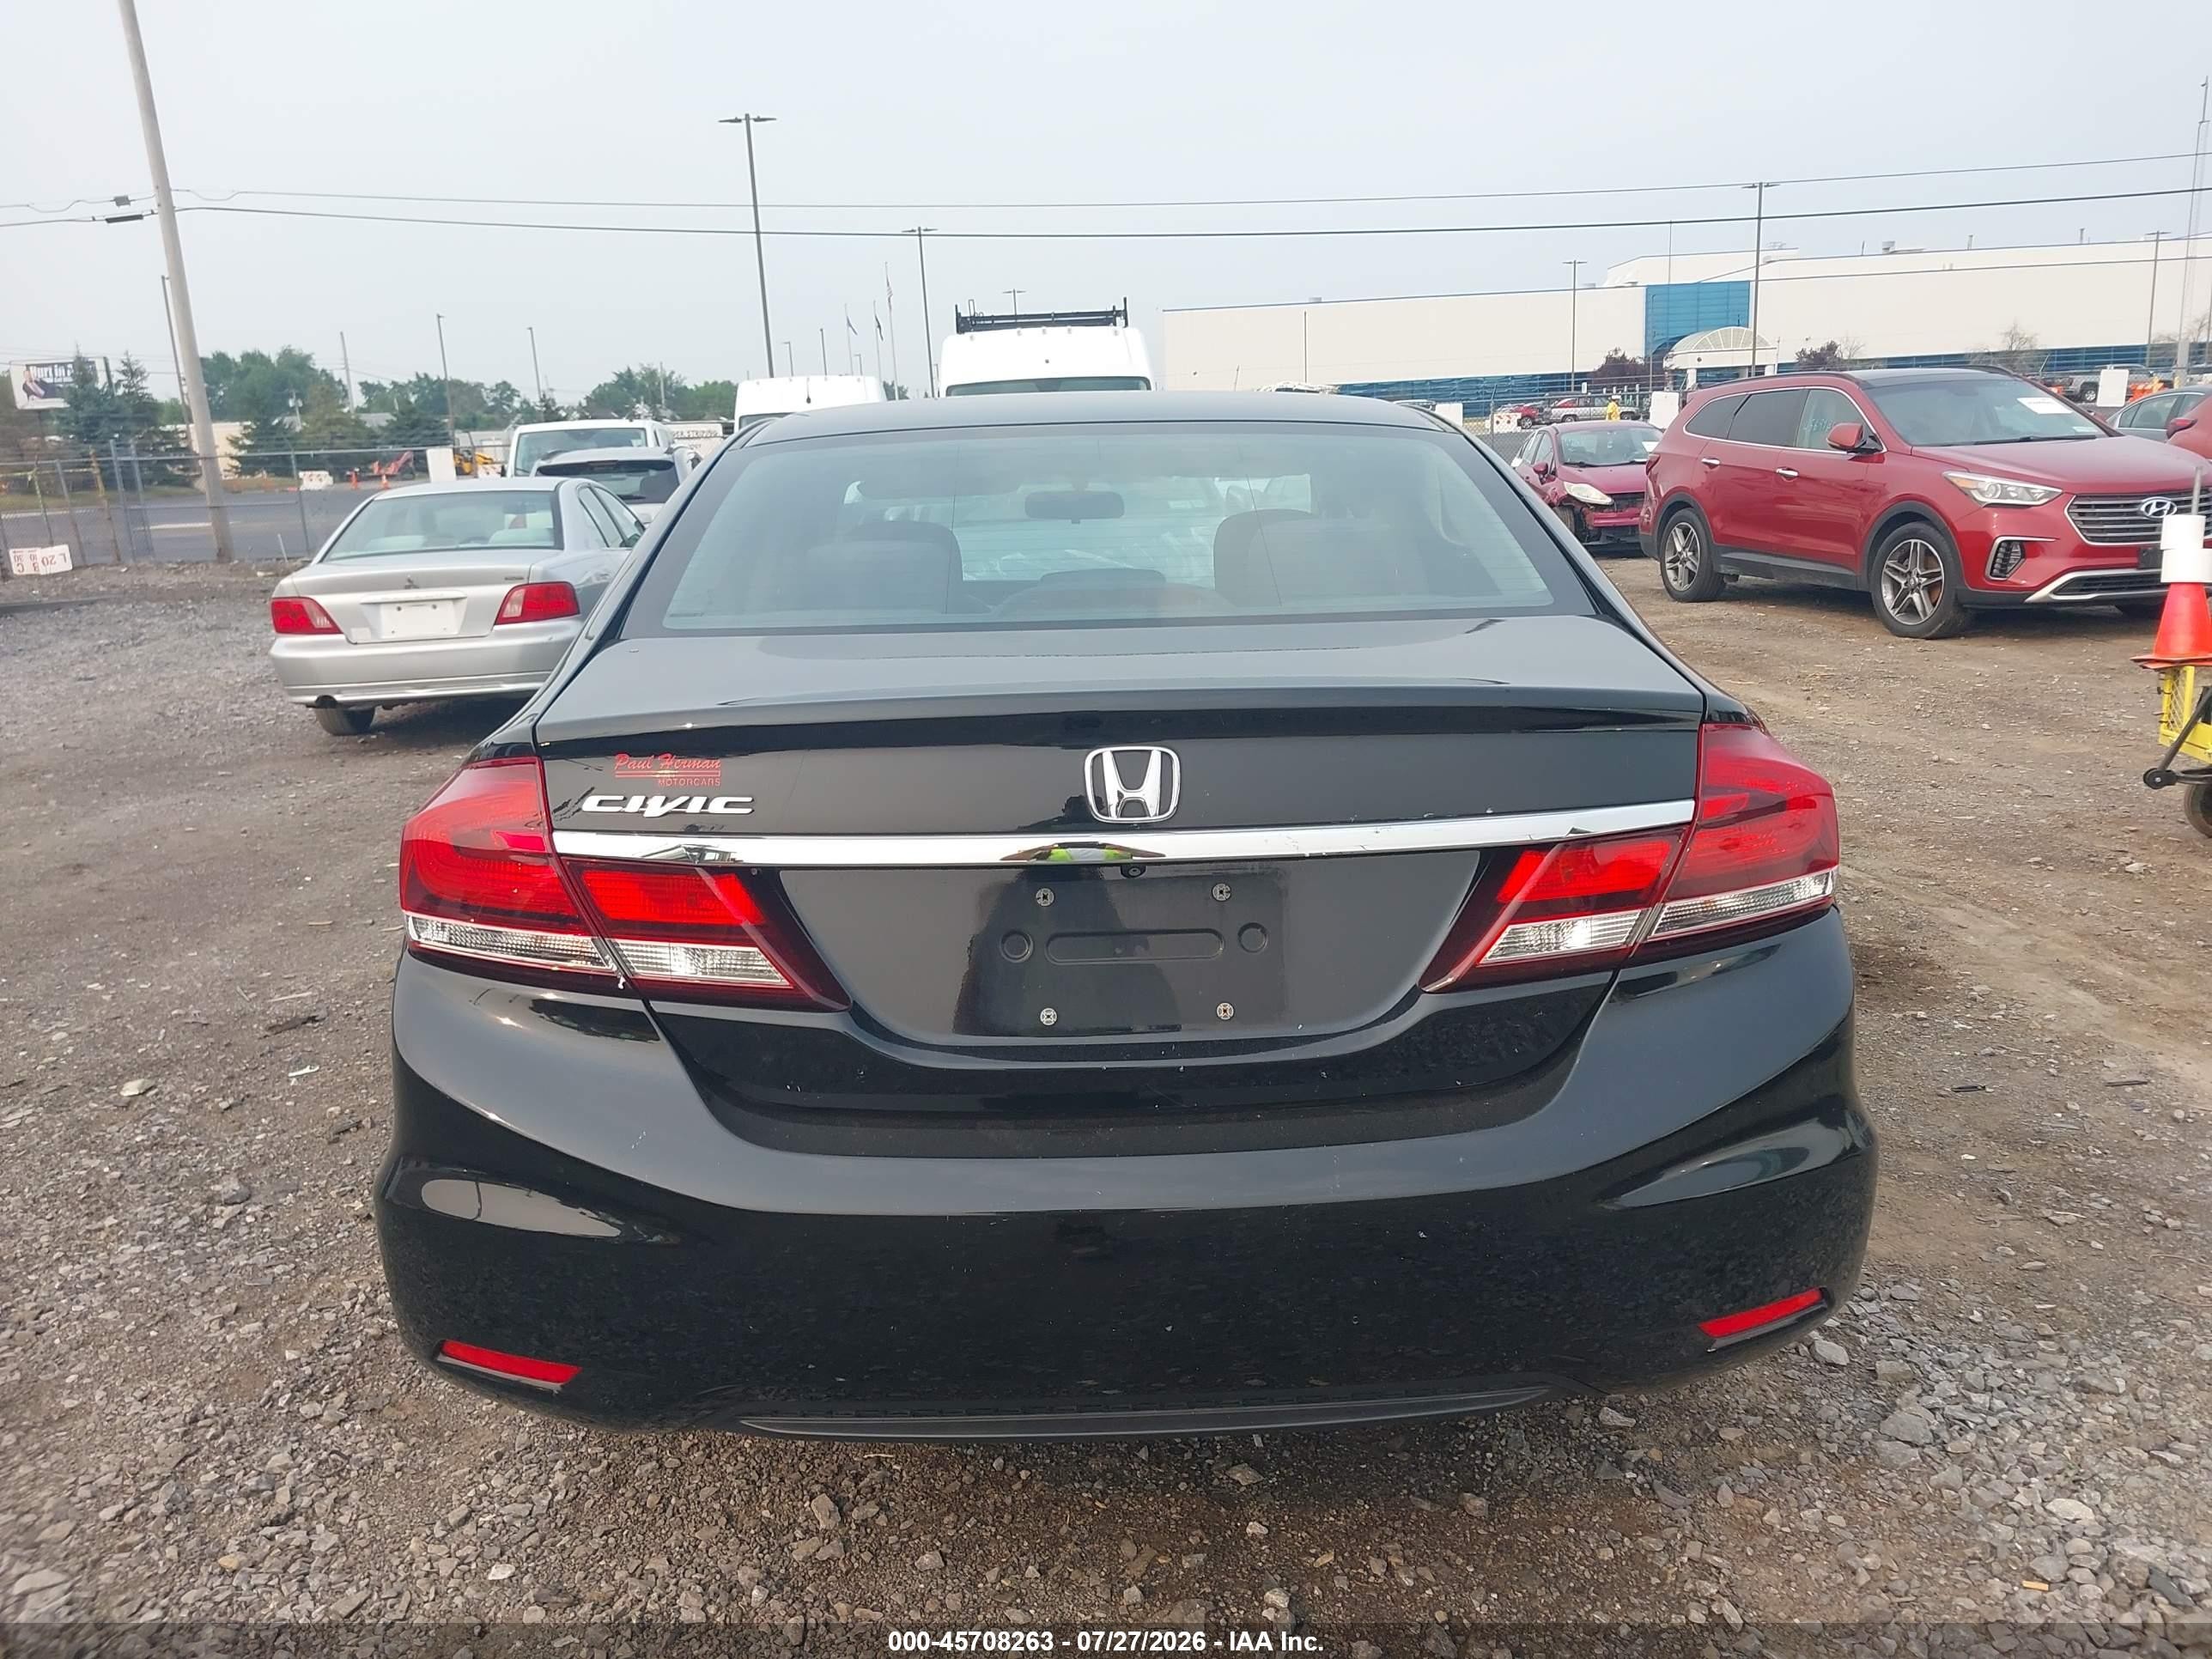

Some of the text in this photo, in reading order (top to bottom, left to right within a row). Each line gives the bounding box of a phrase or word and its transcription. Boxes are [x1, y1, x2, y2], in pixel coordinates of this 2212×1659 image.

[614, 752, 721, 770] Paul Herman
[658, 778, 721, 787] MOTORCARS
[581, 795, 755, 817] CIVIC
